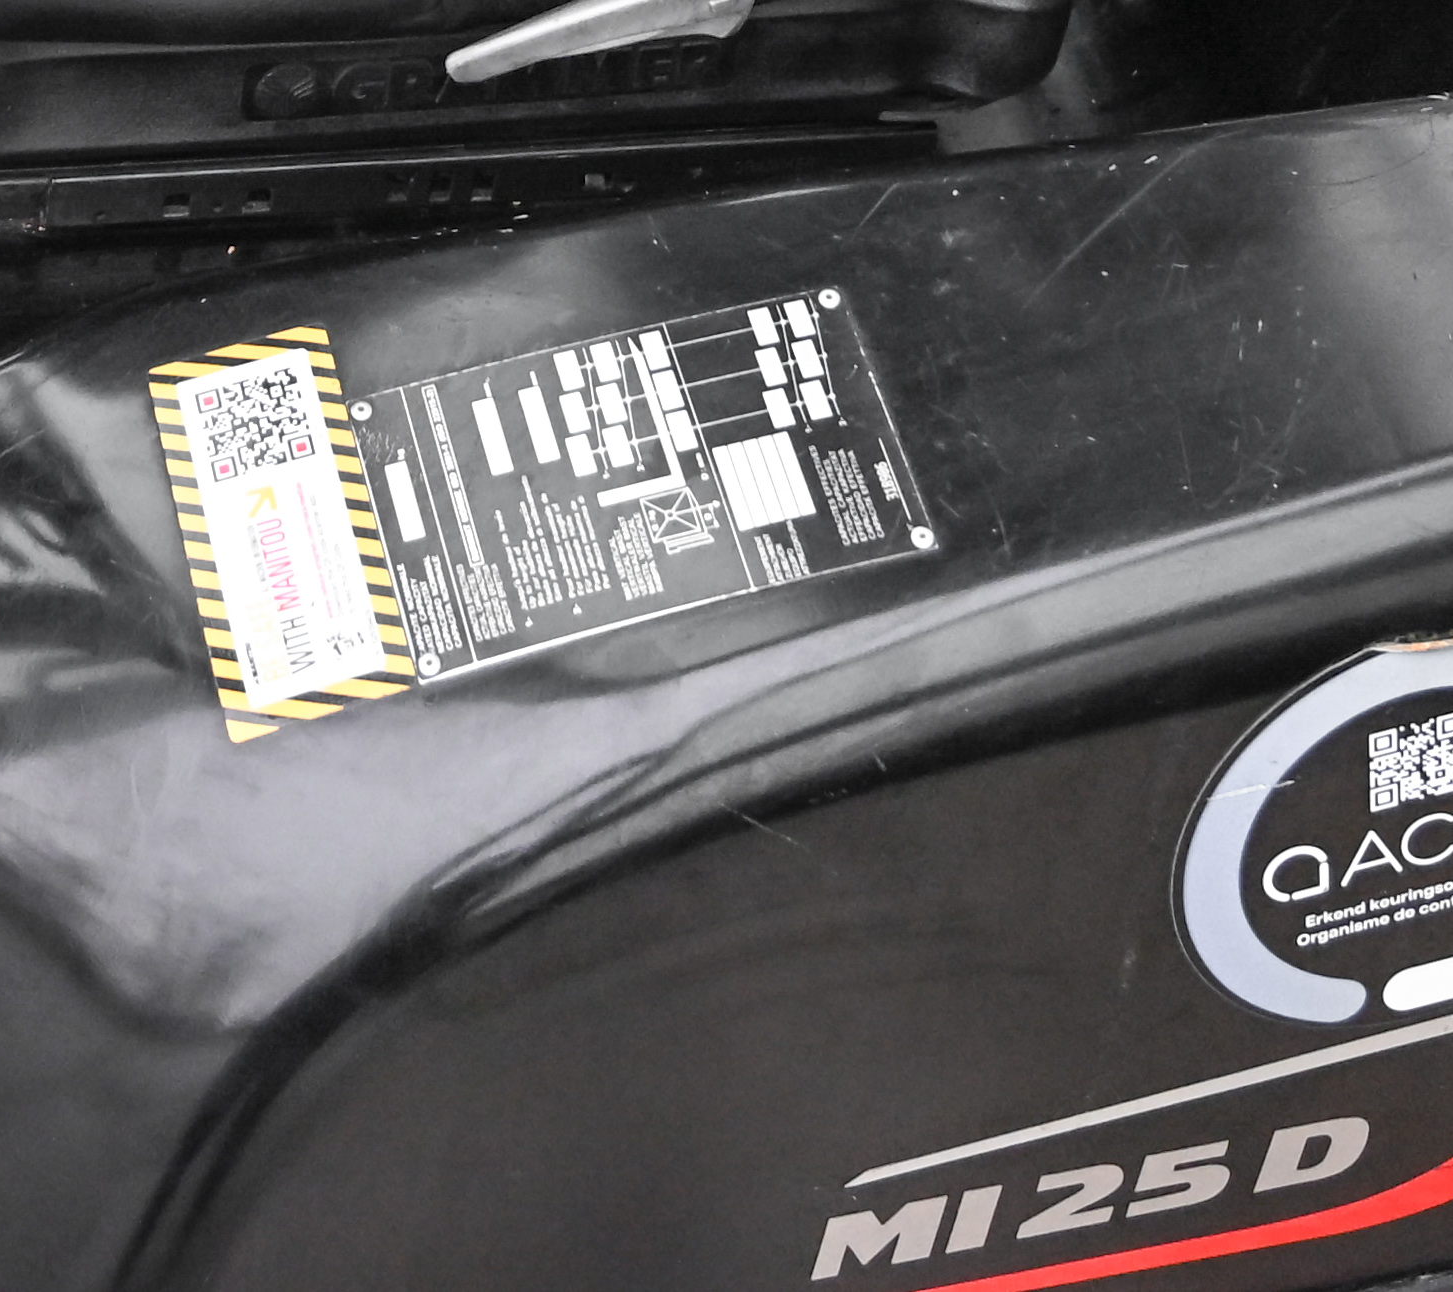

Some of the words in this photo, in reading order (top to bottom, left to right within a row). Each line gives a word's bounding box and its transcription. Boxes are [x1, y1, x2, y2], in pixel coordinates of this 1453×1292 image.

[256, 516, 301, 613] MANITOU
[279, 614, 316, 674] WITH
[811, 1184, 1000, 1281] MI
[1015, 1143, 1231, 1240] 25
[1253, 1117, 1369, 1193] D
